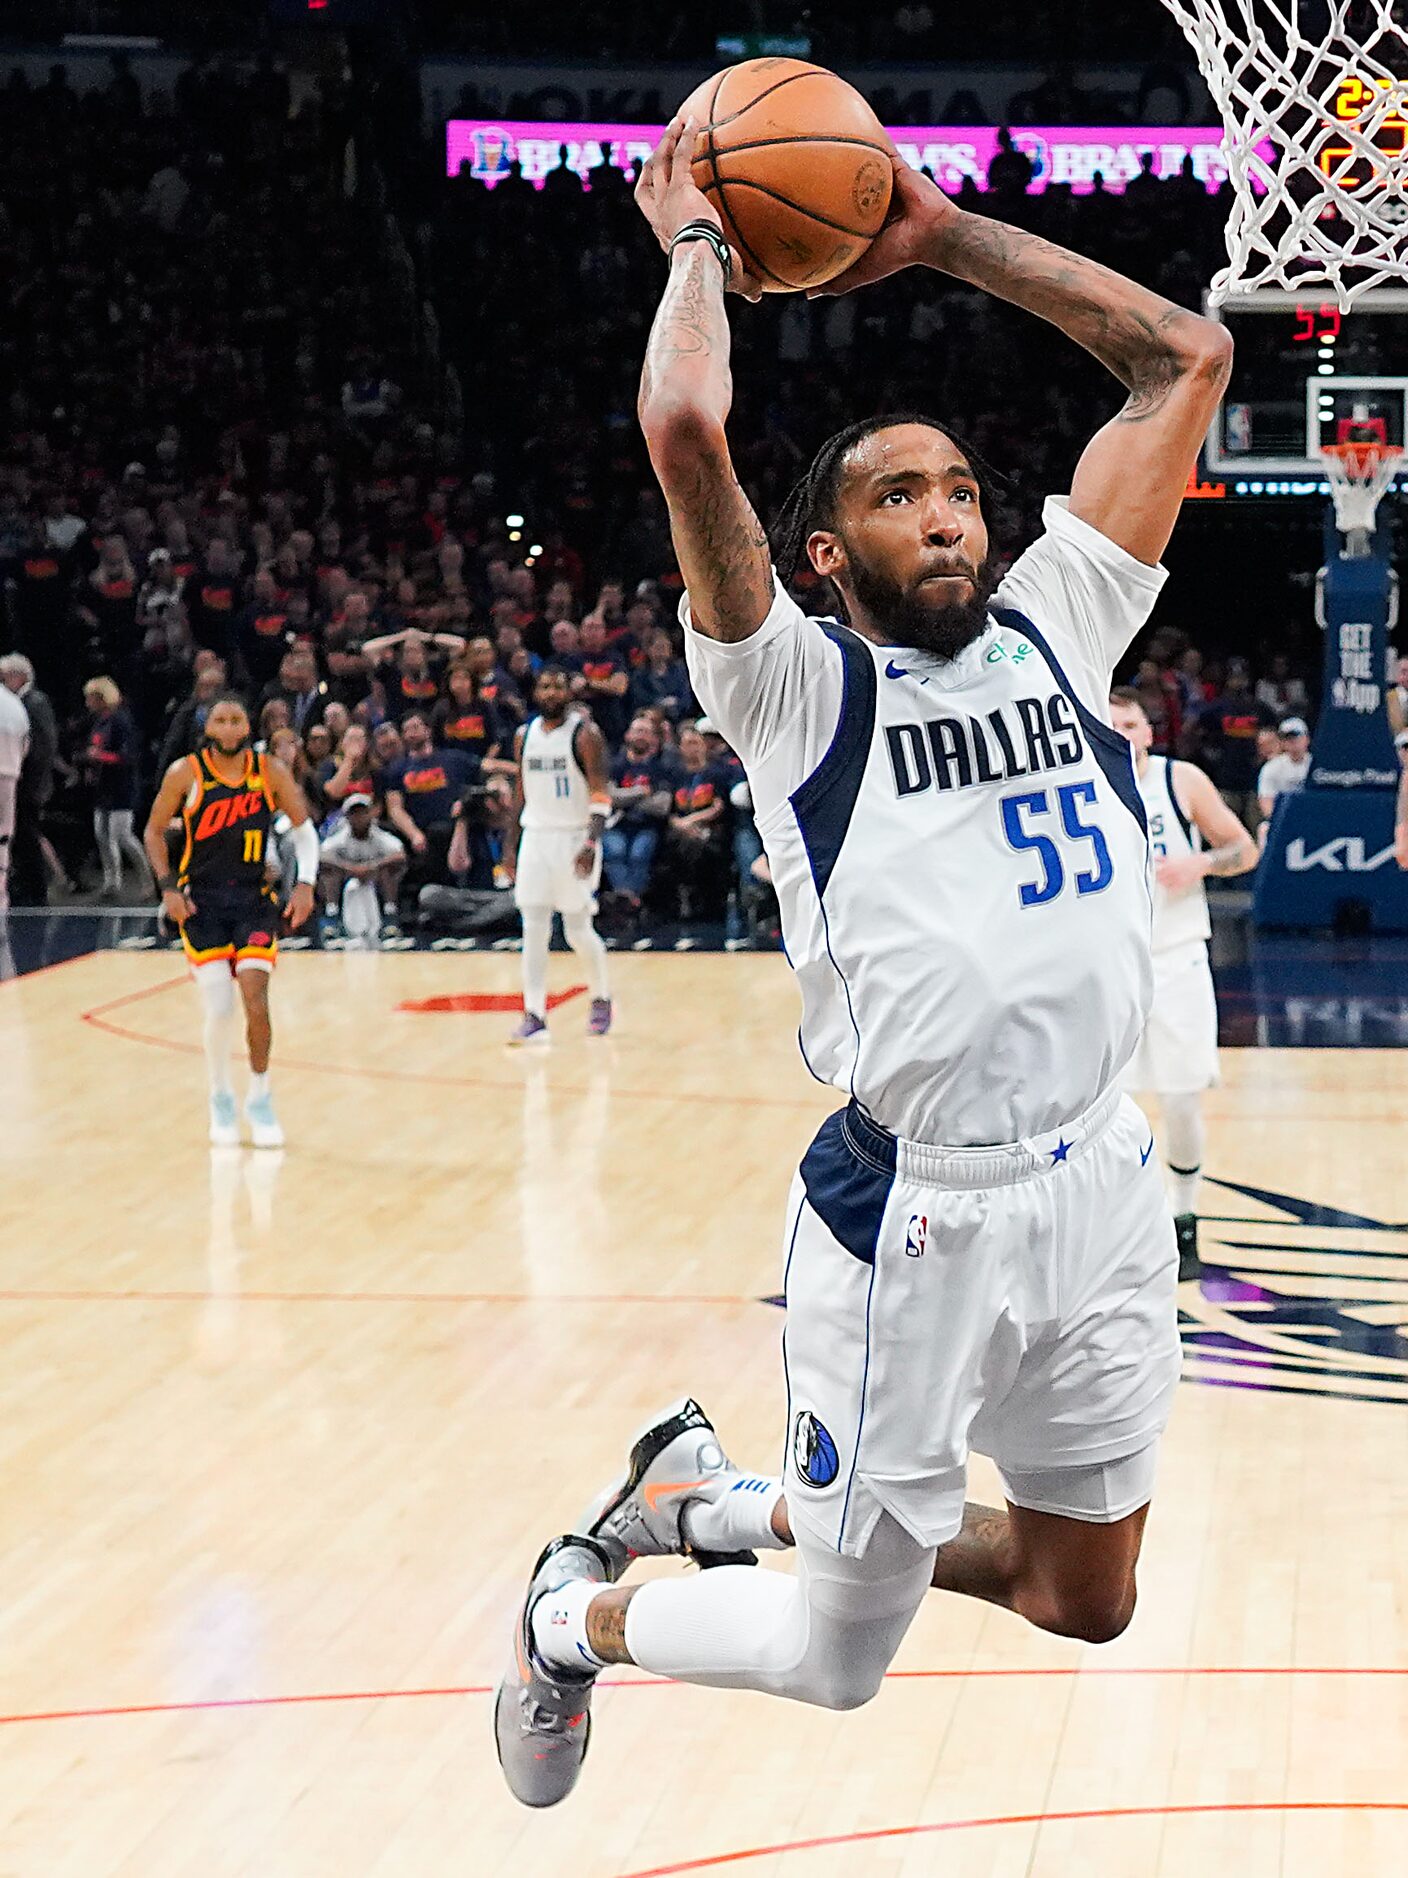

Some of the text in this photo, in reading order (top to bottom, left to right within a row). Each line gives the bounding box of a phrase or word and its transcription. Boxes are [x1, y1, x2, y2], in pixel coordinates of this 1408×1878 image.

[882, 693, 1084, 799] DALLAS
[555, 775, 570, 799] 11
[194, 791, 263, 842] OKC
[242, 829, 263, 863] 11
[999, 778, 1115, 909] 55
